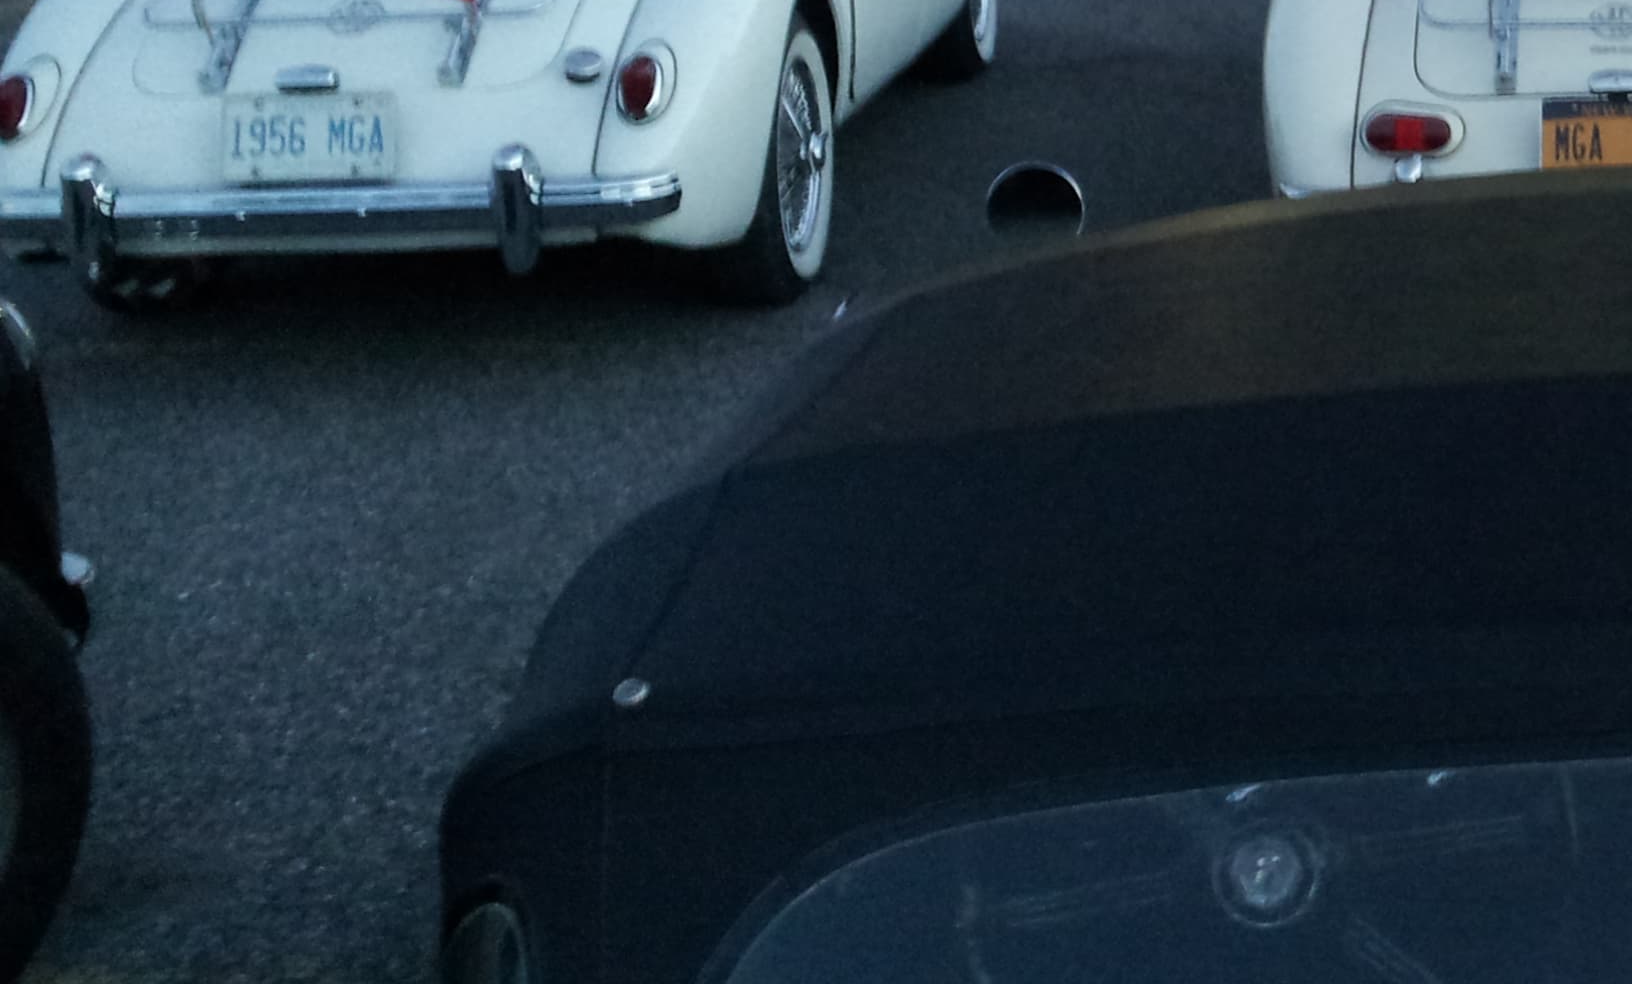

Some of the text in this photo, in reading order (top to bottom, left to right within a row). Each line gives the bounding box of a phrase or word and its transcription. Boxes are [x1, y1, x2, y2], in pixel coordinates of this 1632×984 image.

[231, 114, 385, 160] 1956 MGA
[1554, 122, 1602, 162] MGA
